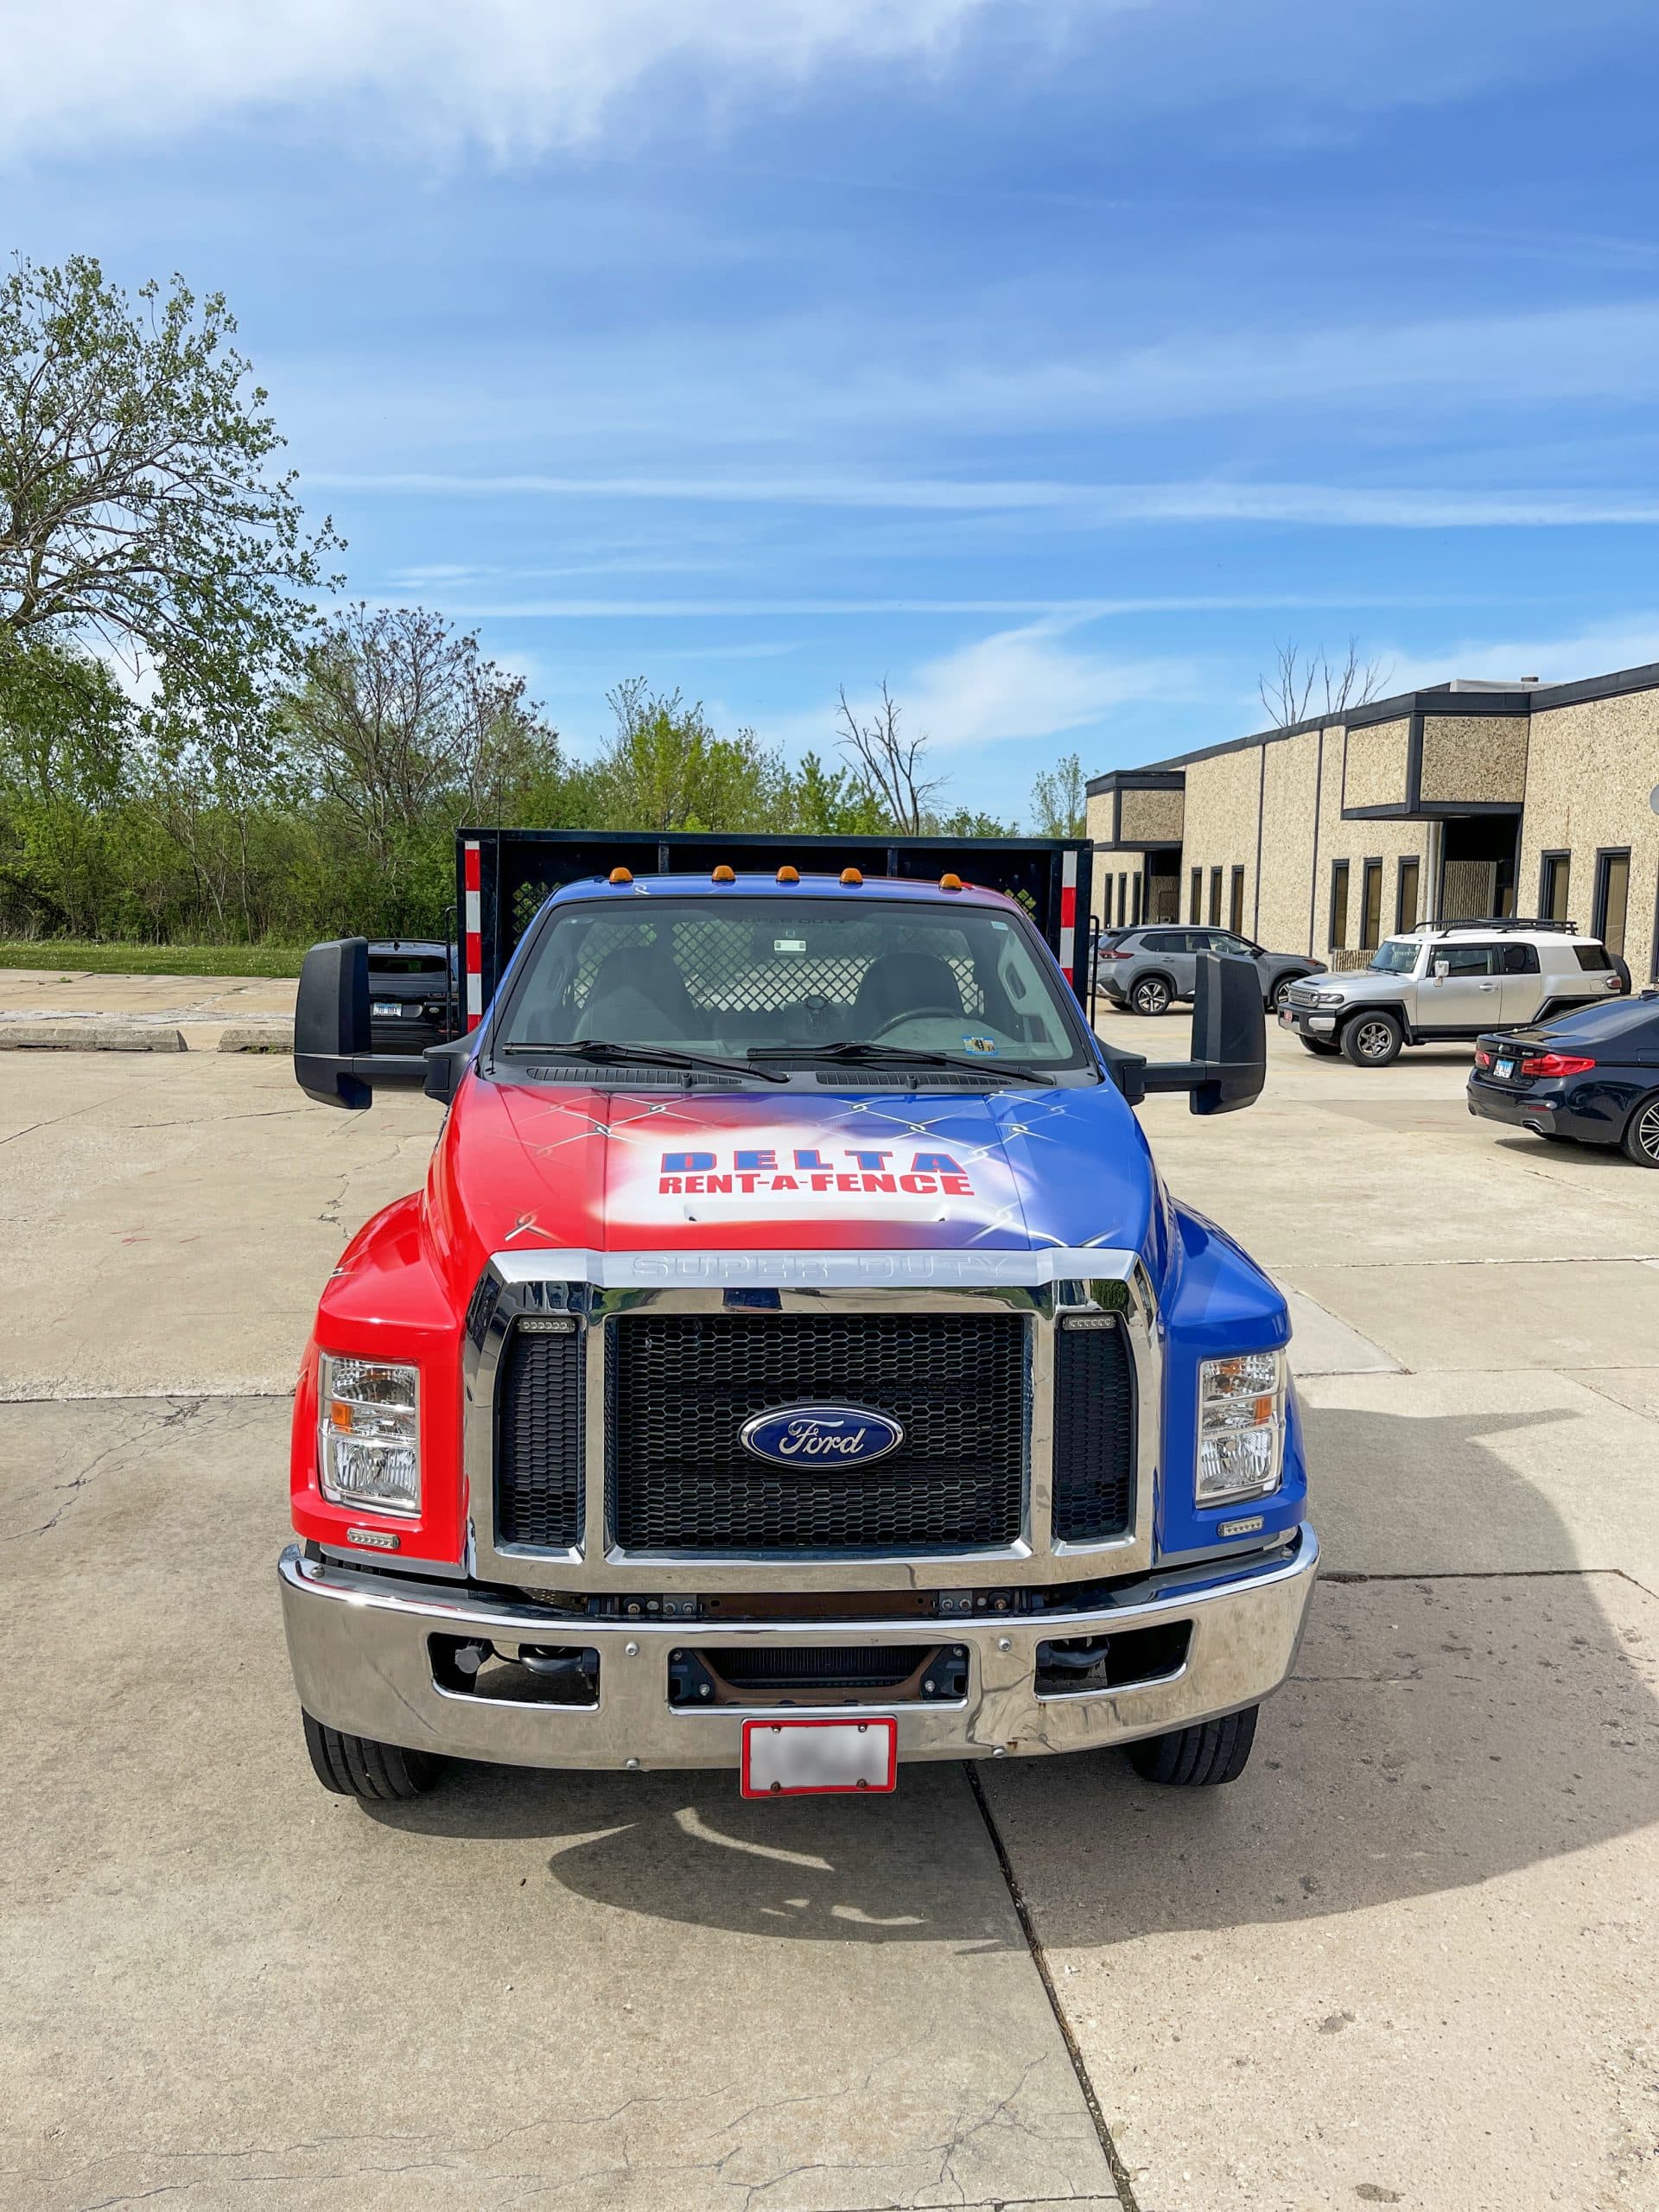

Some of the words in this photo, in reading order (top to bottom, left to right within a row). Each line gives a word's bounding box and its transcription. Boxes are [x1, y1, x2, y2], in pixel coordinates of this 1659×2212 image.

[661, 1149, 967, 1174] DELTA
[658, 1173, 976, 1196] RENT-A-FENCE
[632, 1255, 828, 1279] SUPER
[857, 1255, 1008, 1279] DUTY
[779, 1419, 867, 1455] Ford
